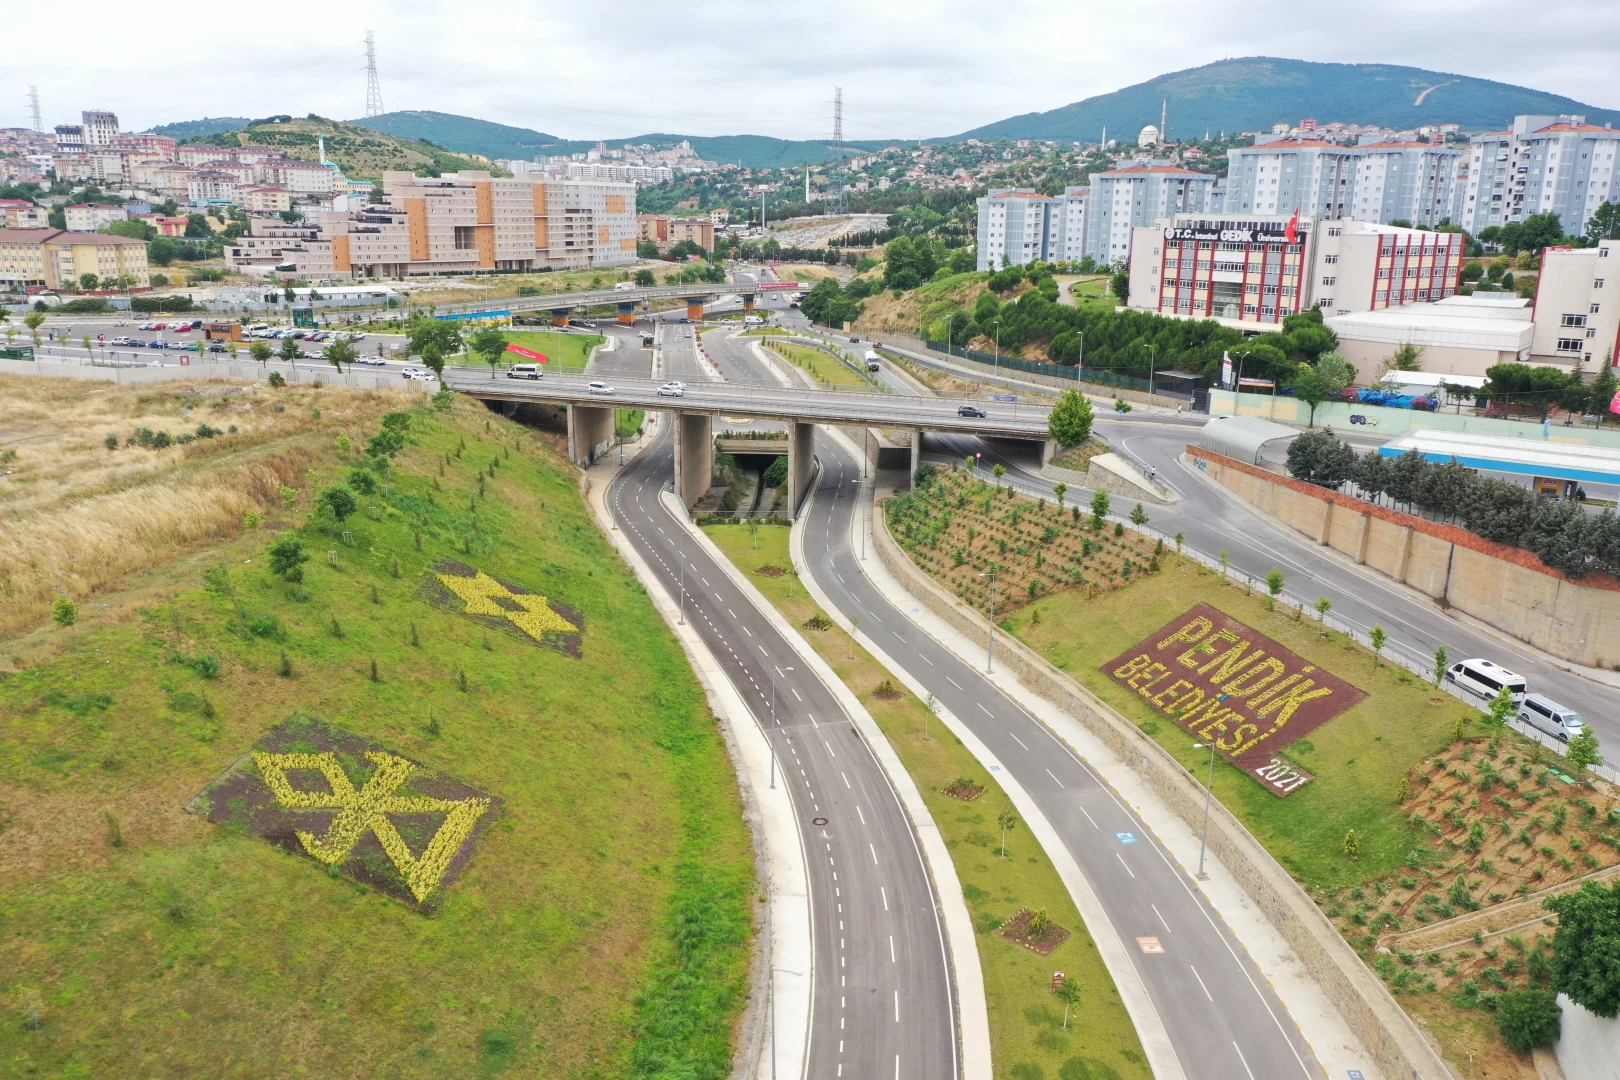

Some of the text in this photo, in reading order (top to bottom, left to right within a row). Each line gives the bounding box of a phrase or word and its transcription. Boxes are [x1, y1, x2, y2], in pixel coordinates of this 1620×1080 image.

[1175, 229, 1194, 239] T.C.
[1220, 227, 1253, 242] GEDİK
[1113, 654, 1277, 757] BELEDİYESİ
[1156, 615, 1333, 728] PENDİK
[1255, 758, 1308, 792] 2021
